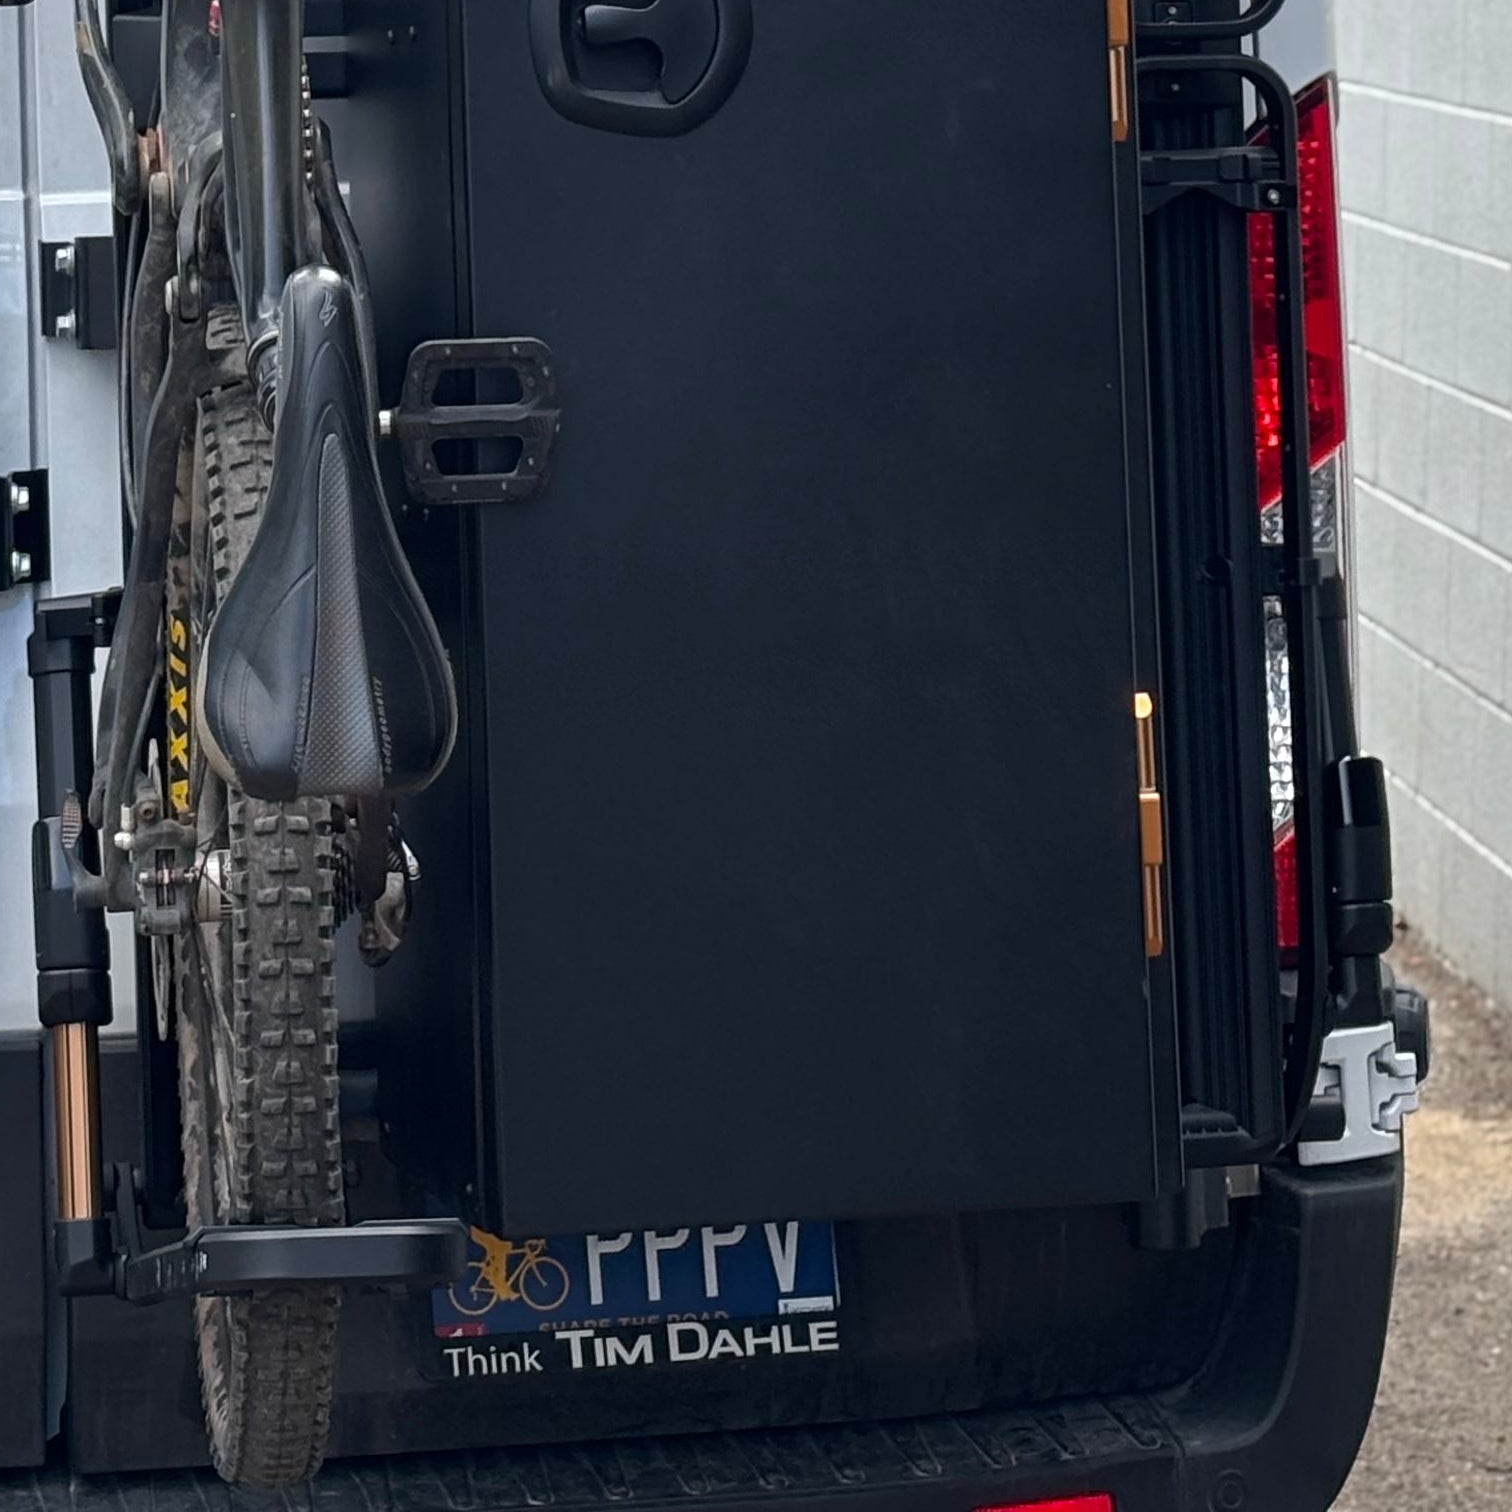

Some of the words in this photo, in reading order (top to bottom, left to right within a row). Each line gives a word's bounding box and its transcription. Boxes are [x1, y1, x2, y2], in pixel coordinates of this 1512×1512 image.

[169, 613, 189, 814] AXXIS
[444, 1341, 543, 1378] Think
[555, 1328, 654, 1369] TIM
[667, 1320, 840, 1363] DAHLE
